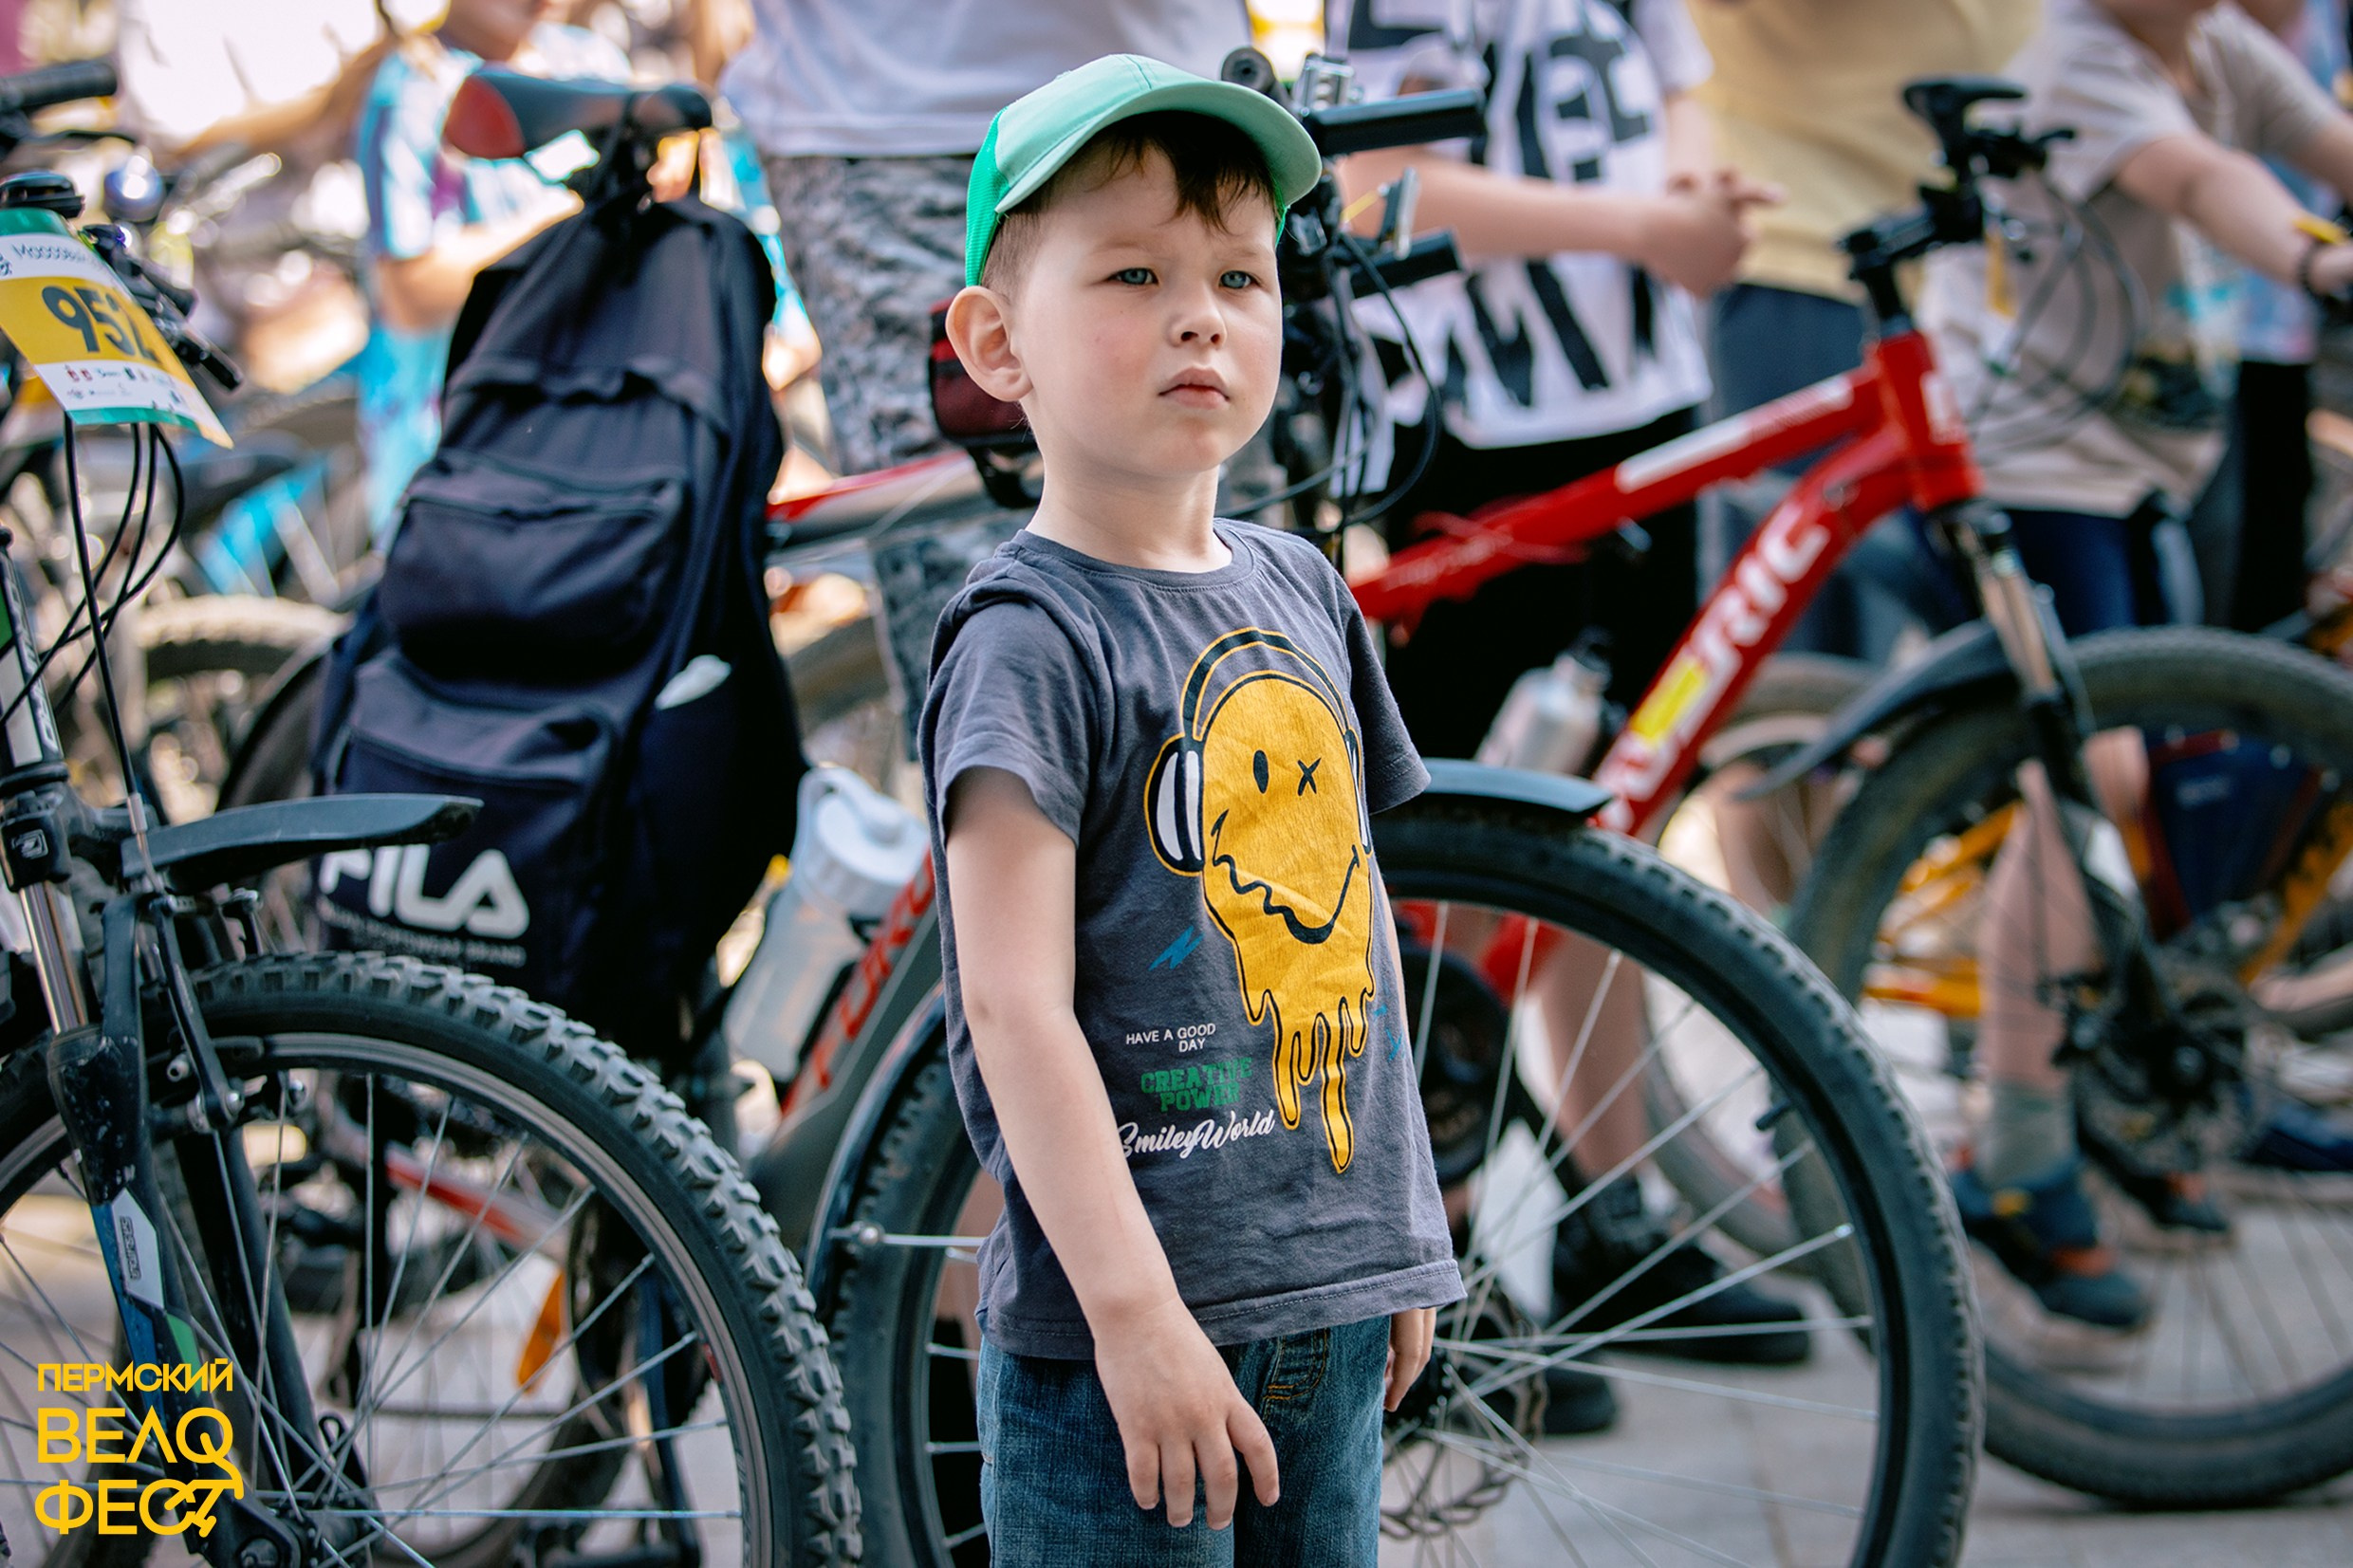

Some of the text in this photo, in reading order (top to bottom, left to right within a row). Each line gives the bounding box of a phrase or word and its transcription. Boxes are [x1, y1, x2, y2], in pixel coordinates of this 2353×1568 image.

[319, 843, 529, 939] FILA
[1126, 1023, 1216, 1044] HAVE A GOOD
[1178, 1038, 1206, 1053] DAY
[1140, 1057, 1253, 1094] CREATIVE
[1160, 1082, 1241, 1113] POWER
[1118, 1108, 1276, 1159] SmileyWorld
